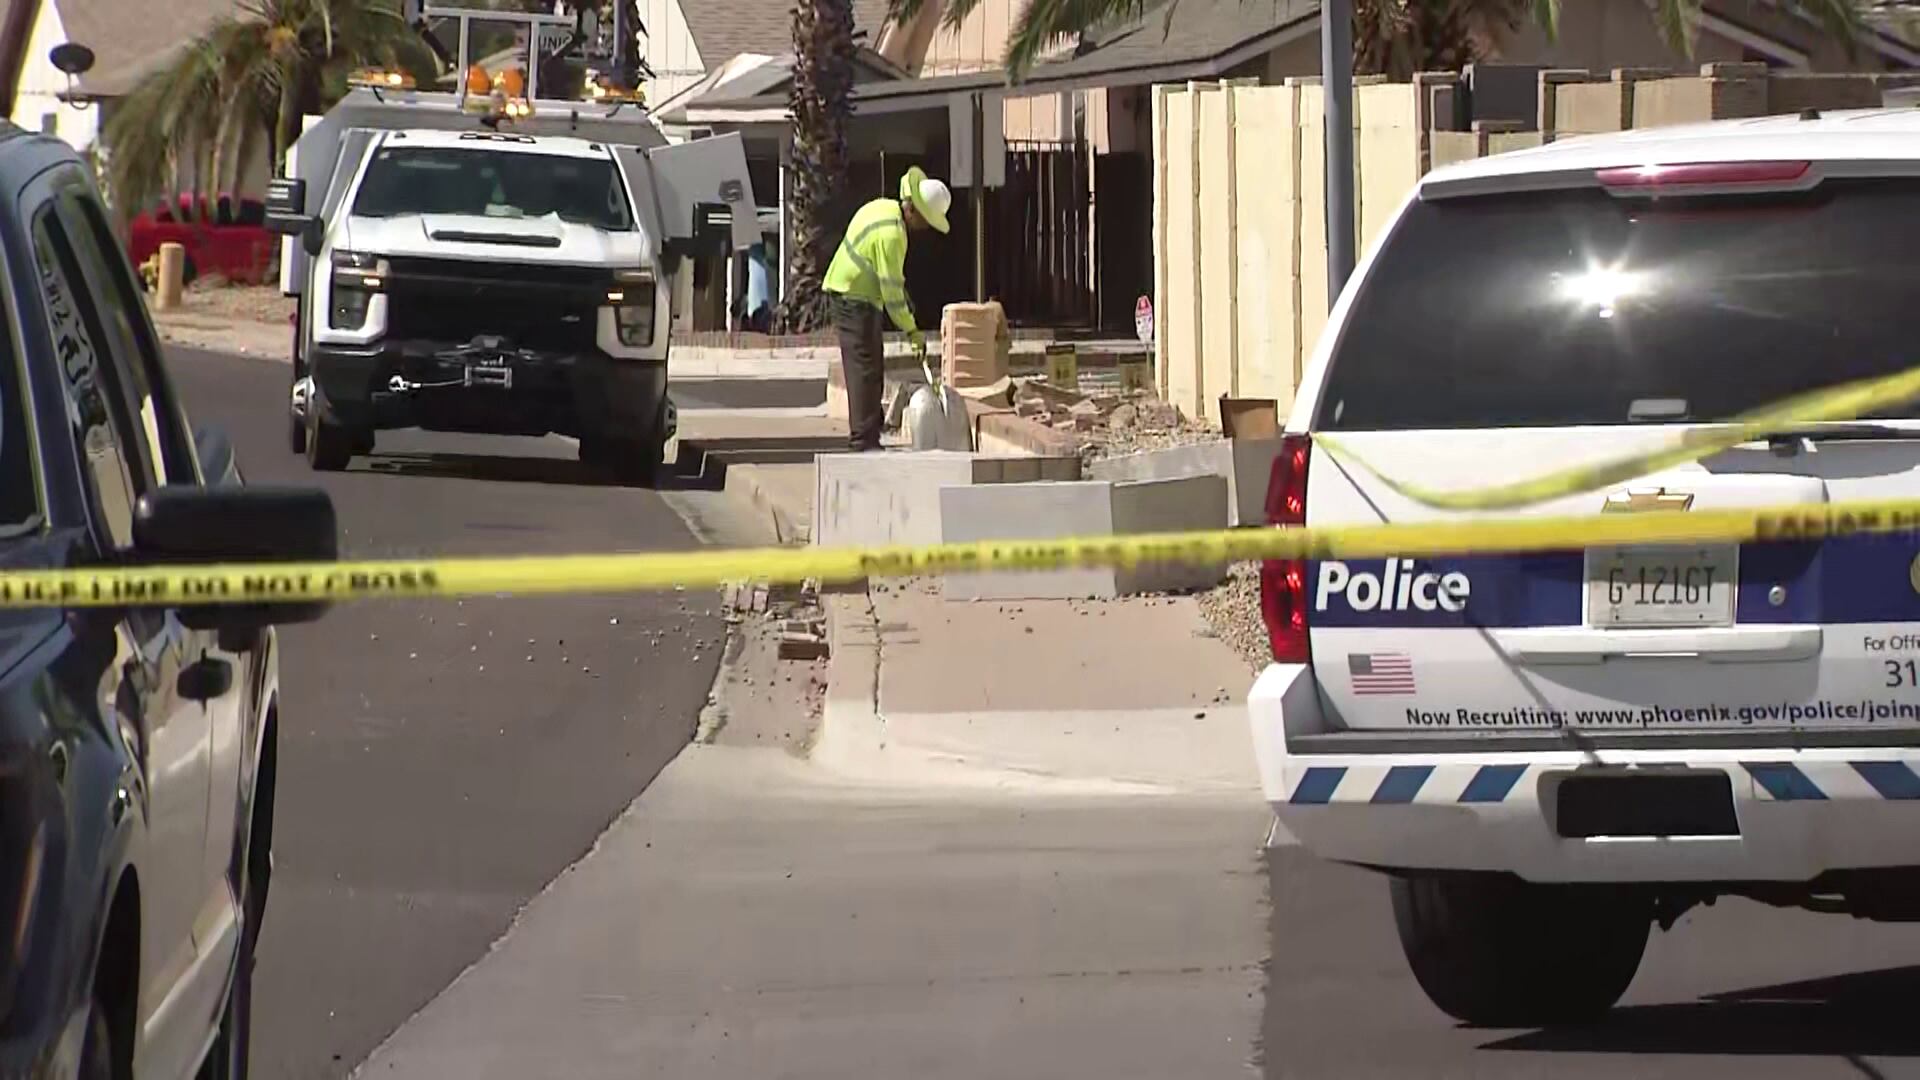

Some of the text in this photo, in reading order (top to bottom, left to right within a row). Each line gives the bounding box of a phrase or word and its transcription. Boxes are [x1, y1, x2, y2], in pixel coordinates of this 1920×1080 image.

[181, 577, 230, 597] DO
[243, 574, 313, 594] NOT
[324, 569, 439, 592] CROSS
[1315, 557, 1471, 612] Police
[1864, 636, 1885, 651] For
[1885, 660, 1917, 687] 31
[1406, 708, 1450, 725] Now
[1457, 707, 1568, 728] Recruiting:
